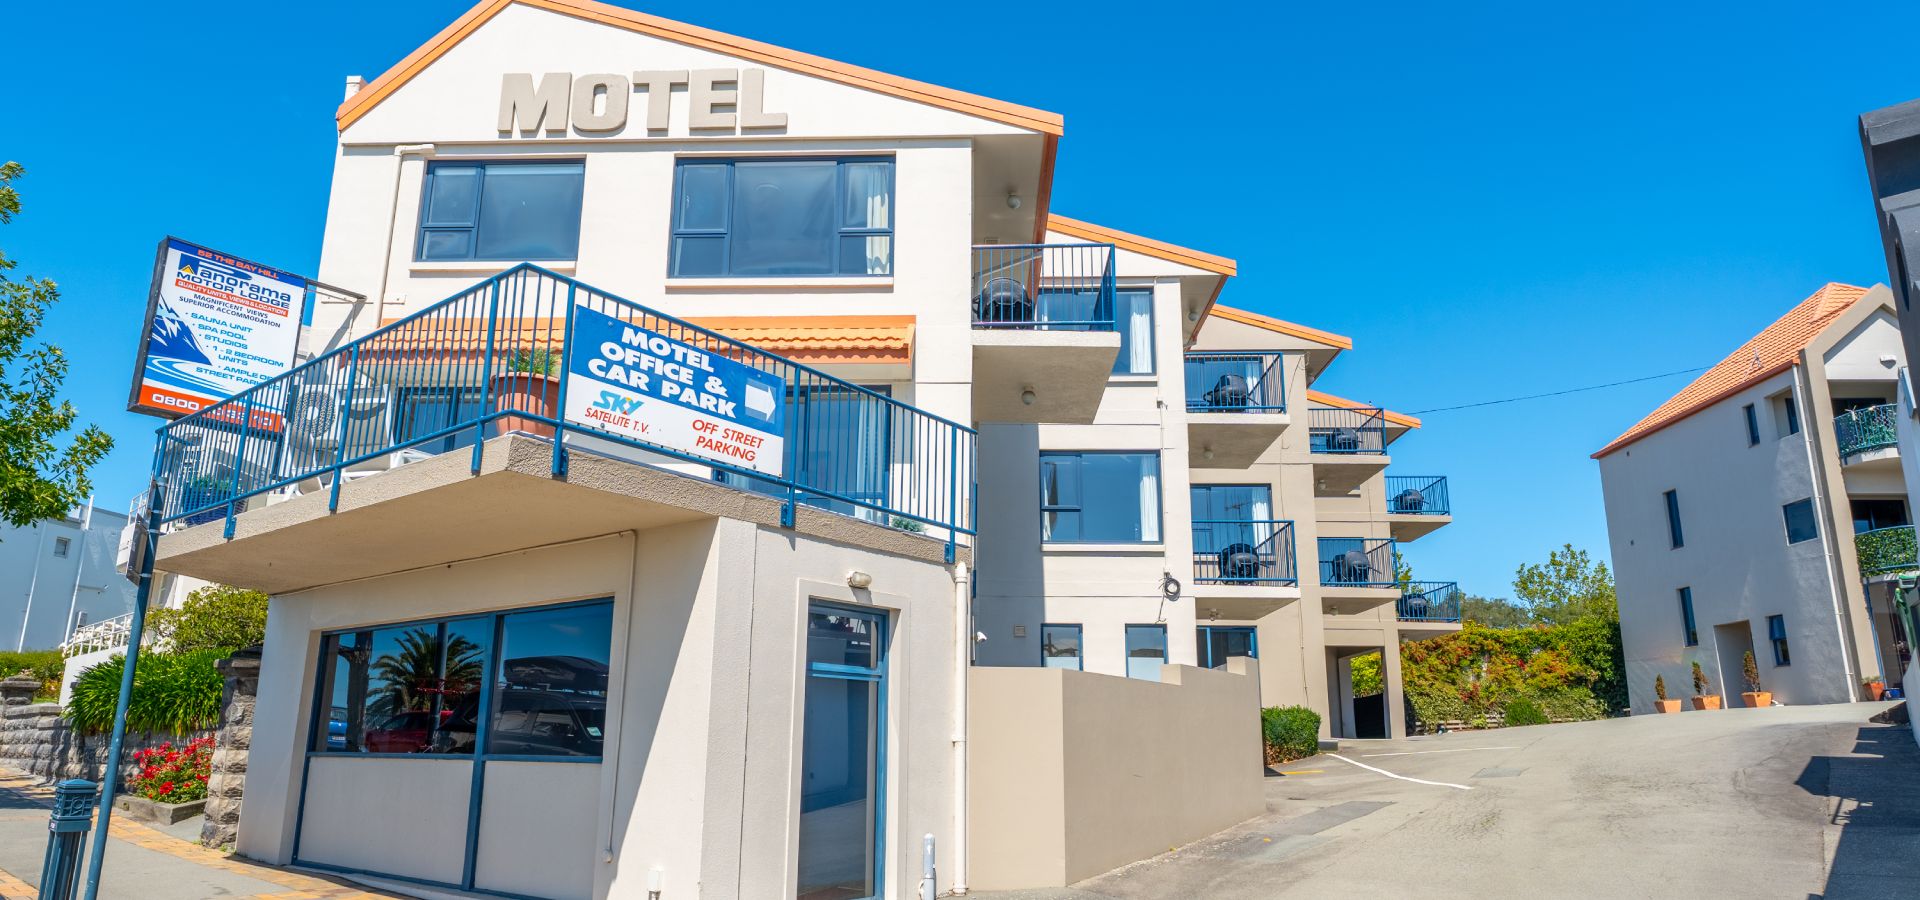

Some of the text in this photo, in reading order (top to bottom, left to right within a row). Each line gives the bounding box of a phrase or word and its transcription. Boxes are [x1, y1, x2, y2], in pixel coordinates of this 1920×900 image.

[497, 68, 788, 132] MOTEL
[197, 249, 279, 279] 52 THE BAY HILL
[177, 280, 208, 293] QUALITY
[177, 271, 290, 310] MOTOR LODGE
[179, 296, 281, 328] SUPERIOR ACCOMMODATION
[193, 293, 268, 319] MAGNIFICENT VIEWS
[190, 312, 253, 333] SAUNA UNIT
[197, 323, 247, 341] SPA POOL
[204, 334, 248, 350] STUDIOS
[621, 326, 714, 373] MOTEL
[218, 354, 248, 366] UNITS
[234, 350, 284, 367] BEDROOM
[600, 341, 729, 398] OFFICE &
[196, 366, 236, 380] STREET
[223, 366, 259, 379] AMPLE
[152, 393, 199, 410] 0800
[588, 359, 736, 419] CAR PARK
[592, 389, 645, 416] SKY
[584, 407, 649, 434] SATELLITE T.V.
[692, 419, 765, 449] OFF STREET
[696, 435, 756, 462] PARKING
